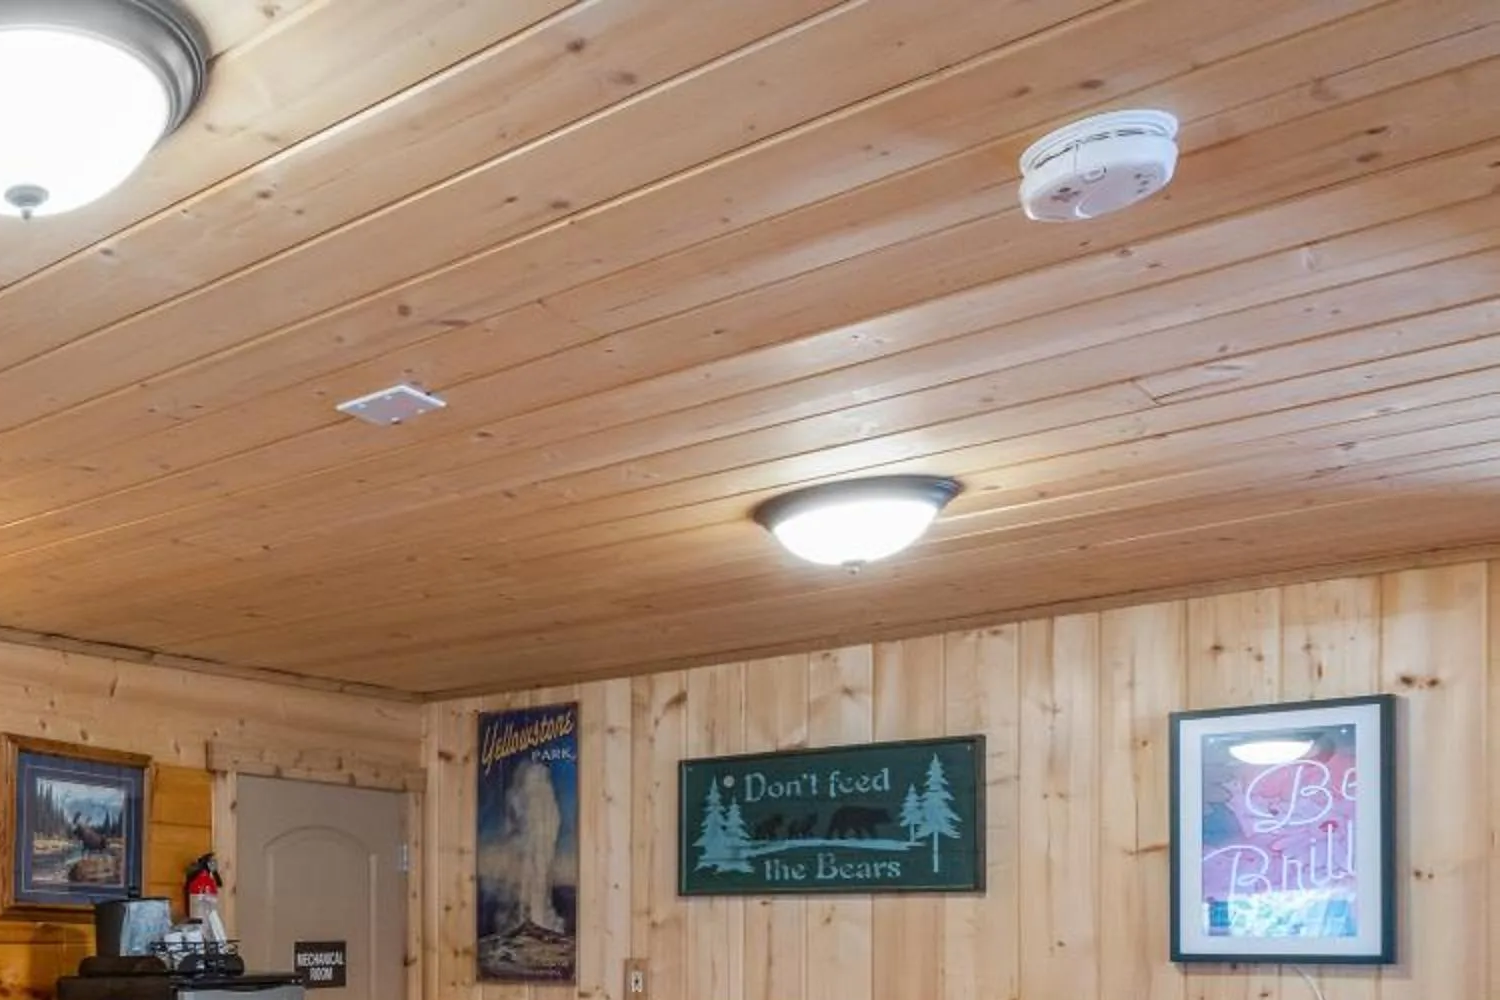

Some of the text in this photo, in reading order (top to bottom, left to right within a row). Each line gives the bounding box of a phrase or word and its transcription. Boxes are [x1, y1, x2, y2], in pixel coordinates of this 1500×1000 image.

[481, 710, 573, 776] Yellowstone
[531, 748, 571, 764] PARK
[744, 767, 891, 802] Don't feed
[764, 852, 901, 881] the Bears
